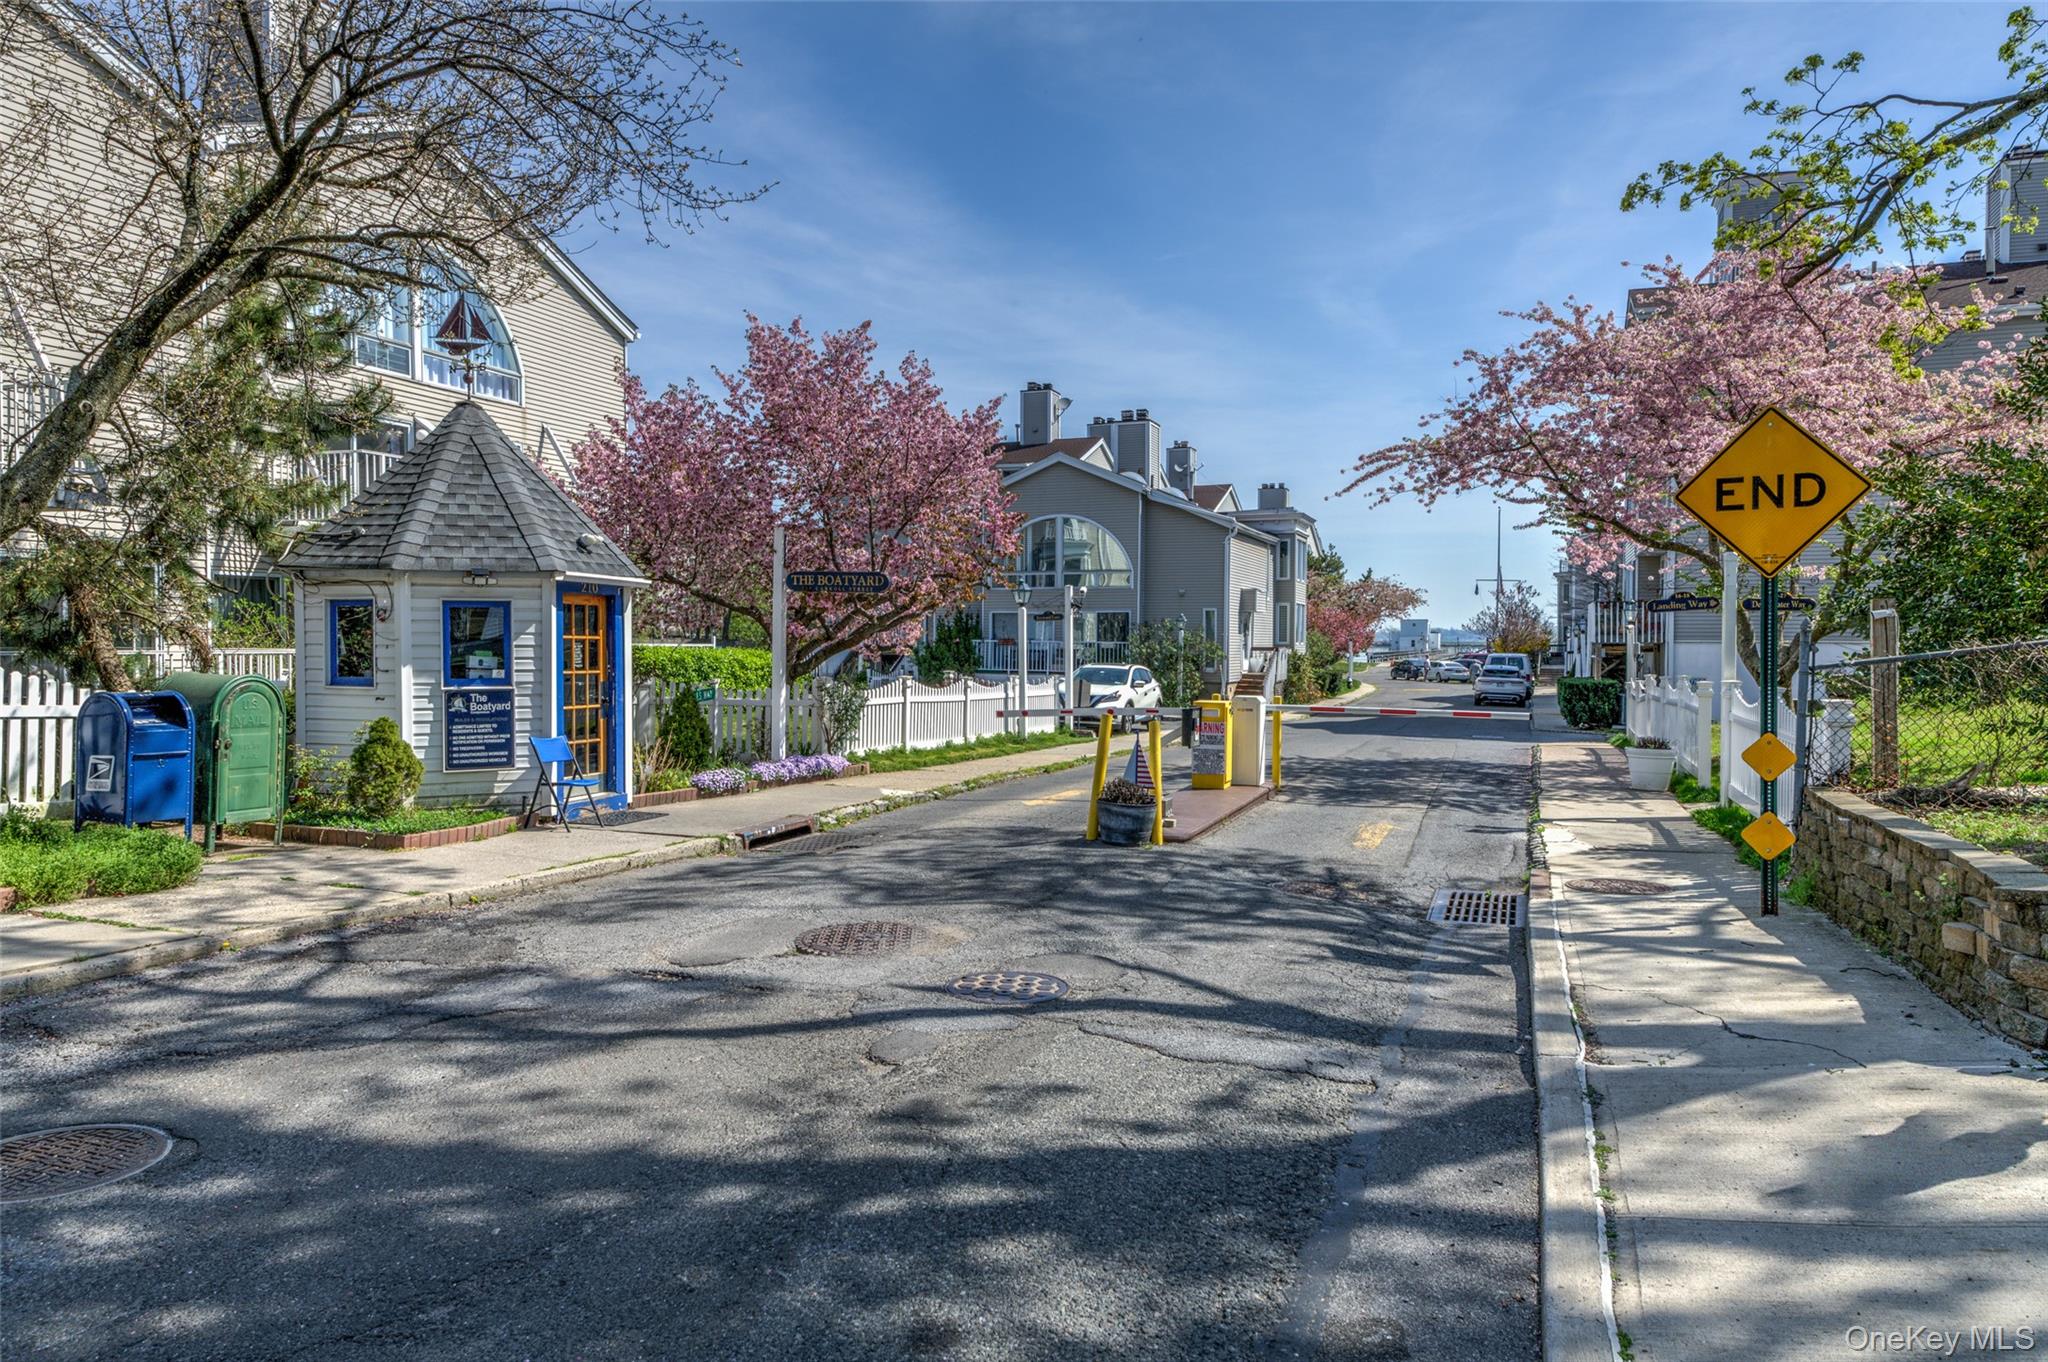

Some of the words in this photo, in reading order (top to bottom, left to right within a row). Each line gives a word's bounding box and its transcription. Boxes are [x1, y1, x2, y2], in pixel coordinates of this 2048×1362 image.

[1716, 473, 1826, 512] END
[791, 574, 815, 586] THE
[817, 574, 885, 586] BOATYARD
[581, 582, 599, 593] 210
[1653, 601, 1687, 610] Landing
[1688, 600, 1708, 609] Way
[1790, 600, 1805, 608] Way
[470, 693, 488, 702] The
[470, 701, 511, 712] Boatyard
